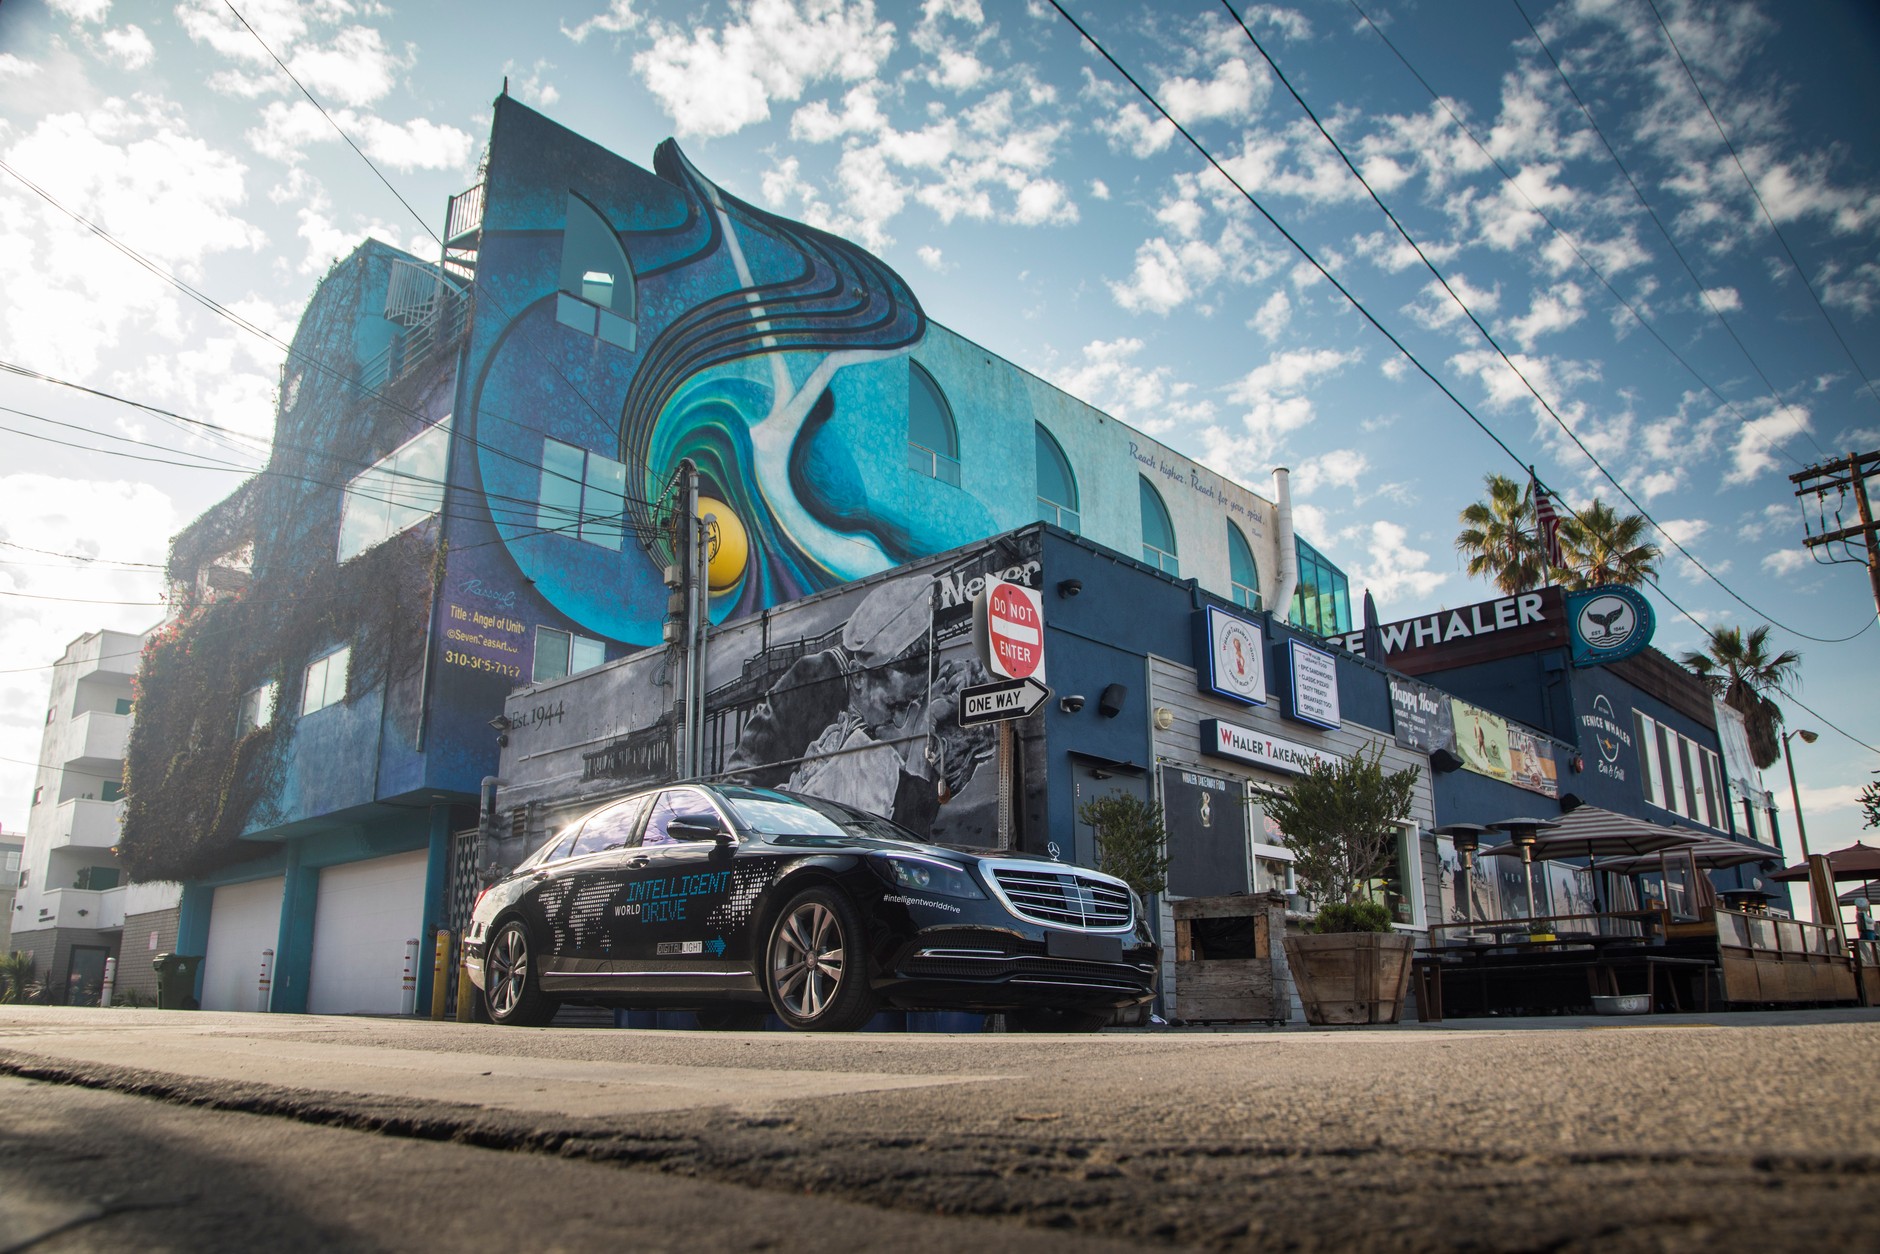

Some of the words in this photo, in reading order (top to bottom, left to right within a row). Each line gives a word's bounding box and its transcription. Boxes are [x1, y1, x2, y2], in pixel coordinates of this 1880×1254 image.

[1129, 442, 1155, 469] Reach
[1160, 461, 1187, 485] higher.
[1191, 473, 1214, 499] Reach
[1218, 491, 1228, 505] for
[940, 561, 1041, 610] Neer
[451, 605, 467, 621] Title
[473, 611, 496, 629] Angel
[497, 618, 505, 630] of
[994, 597, 1006, 614] DO
[1010, 602, 1032, 622] NOT
[1380, 593, 1546, 654] WHALER
[1000, 640, 1031, 663] ENTER
[968, 696, 991, 713] ONE
[996, 691, 1021, 708] WAY
[1390, 681, 1418, 713] Happy
[1418, 692, 1438, 715] Hour
[511, 711, 530, 730] Est.
[531, 701, 565, 731] 1944
[1220, 727, 1263, 756] WHALER
[1581, 715, 1603, 729] VENICE
[1604, 719, 1631, 747] WHALER
[626, 871, 731, 902] INTELLIGENT
[614, 903, 641, 917] WORLD
[641, 898, 687, 923] DRIVE
[883, 893, 961, 914] #intelligentworlddrive
[682, 942, 701, 952] LIGHT
